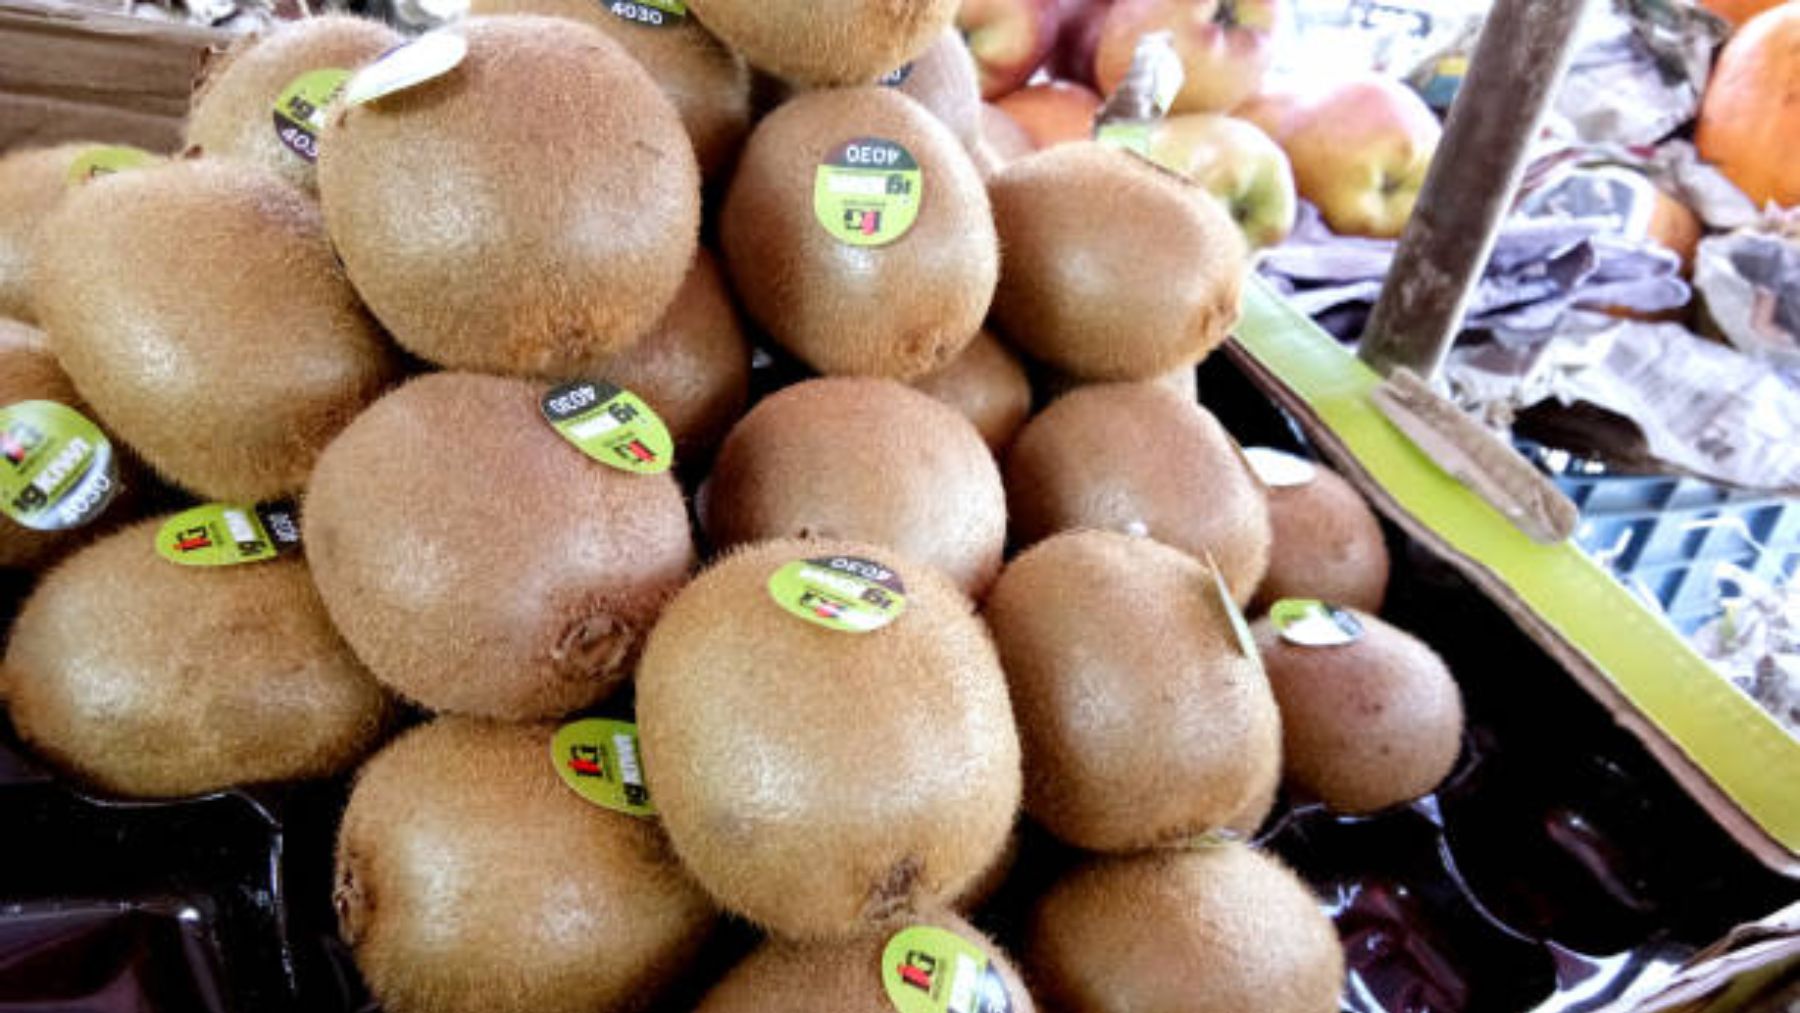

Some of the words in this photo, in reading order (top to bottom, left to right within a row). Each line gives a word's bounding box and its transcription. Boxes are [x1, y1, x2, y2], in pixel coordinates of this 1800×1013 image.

[611, 1, 663, 24] 4030
[846, 144, 902, 165] 4030
[548, 384, 596, 415] 4030
[830, 557, 894, 581] 4030
